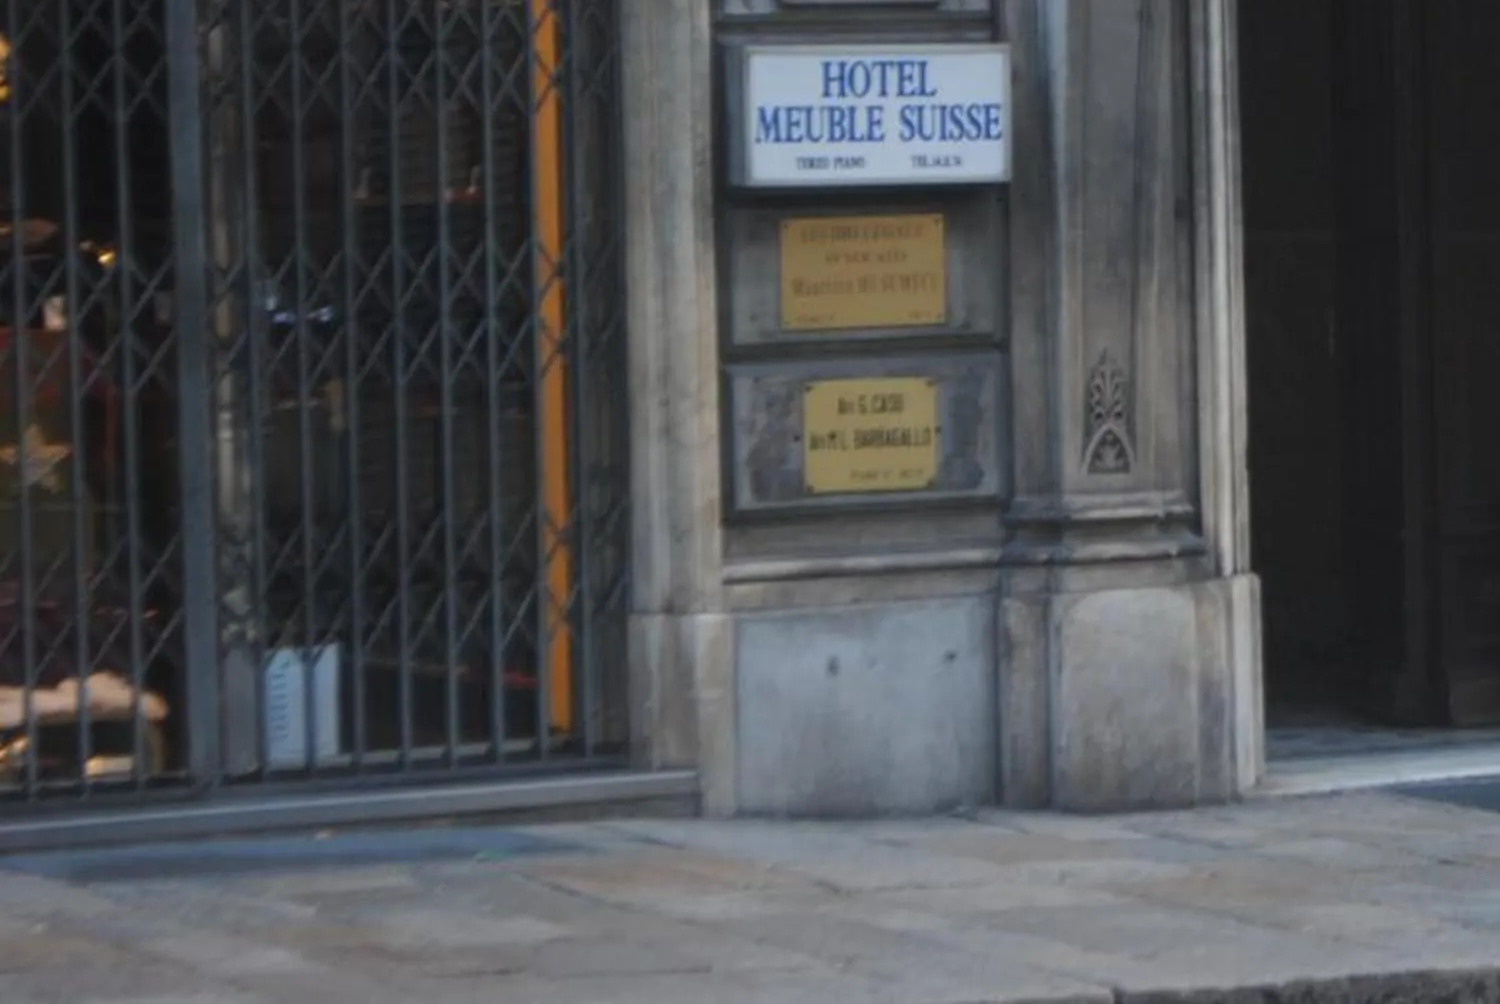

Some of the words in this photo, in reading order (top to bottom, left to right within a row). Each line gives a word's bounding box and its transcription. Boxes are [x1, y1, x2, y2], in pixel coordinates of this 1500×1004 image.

[820, 59, 938, 98] HOTEL
[755, 105, 886, 144] MEUBLE
[898, 103, 1003, 142] SUISSE
